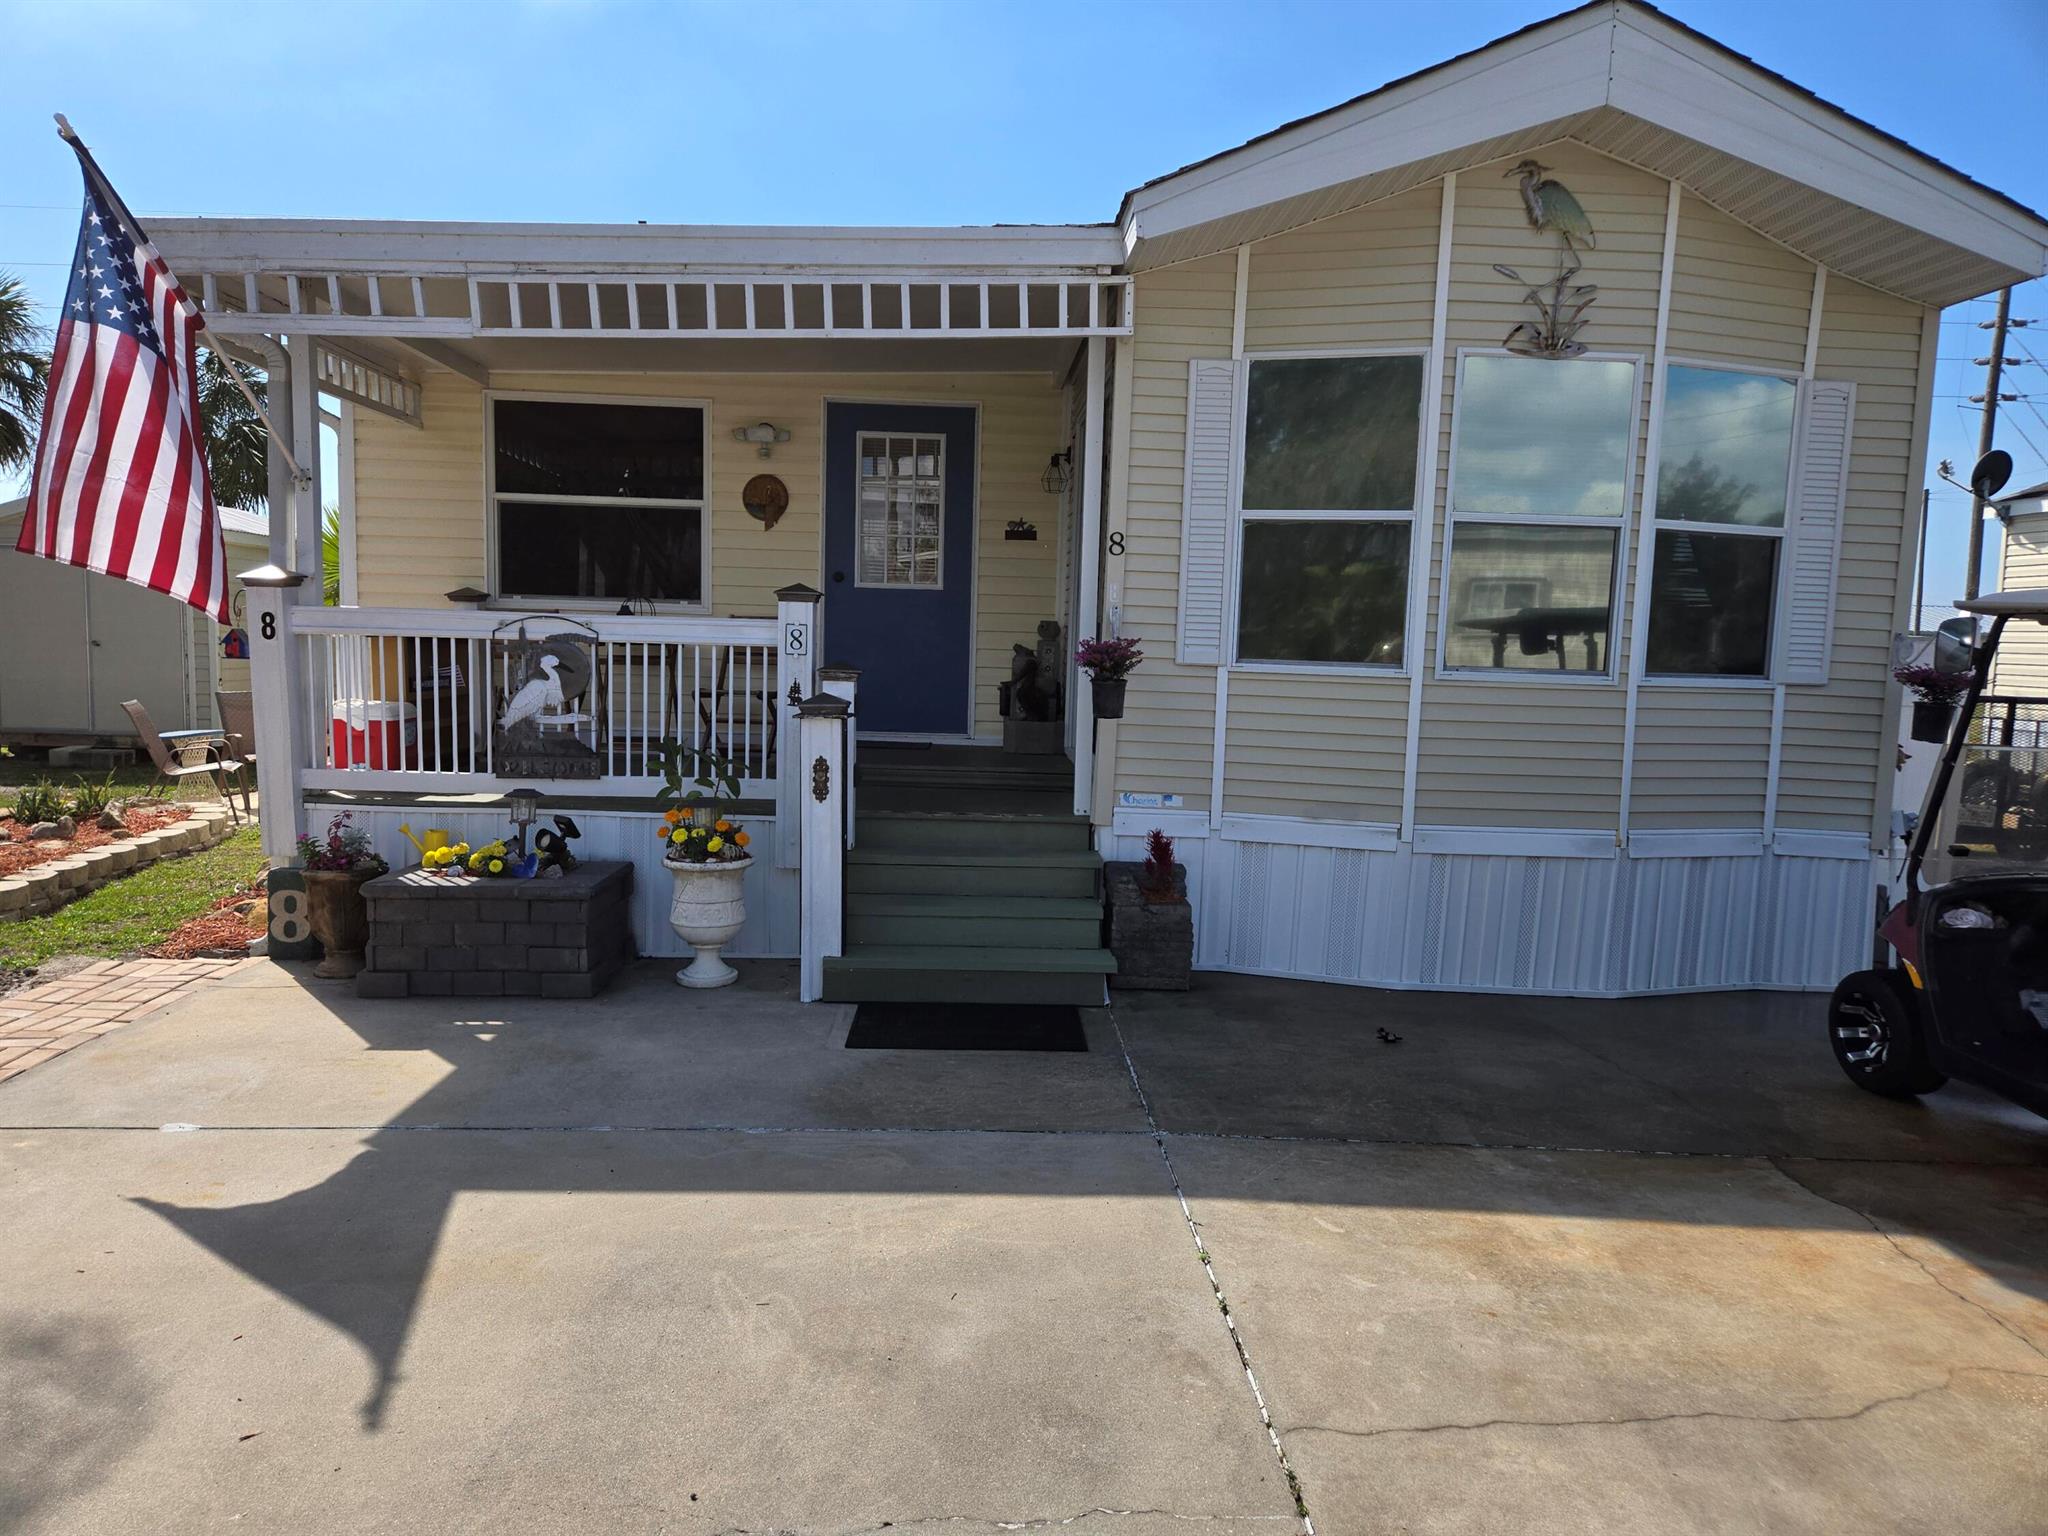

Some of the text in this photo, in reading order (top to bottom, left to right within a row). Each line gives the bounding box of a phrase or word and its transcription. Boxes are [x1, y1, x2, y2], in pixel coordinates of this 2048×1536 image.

[1109, 531, 1125, 556] 8
[261, 611, 276, 640] 8
[790, 628, 803, 650] 8
[269, 889, 311, 943] 8
